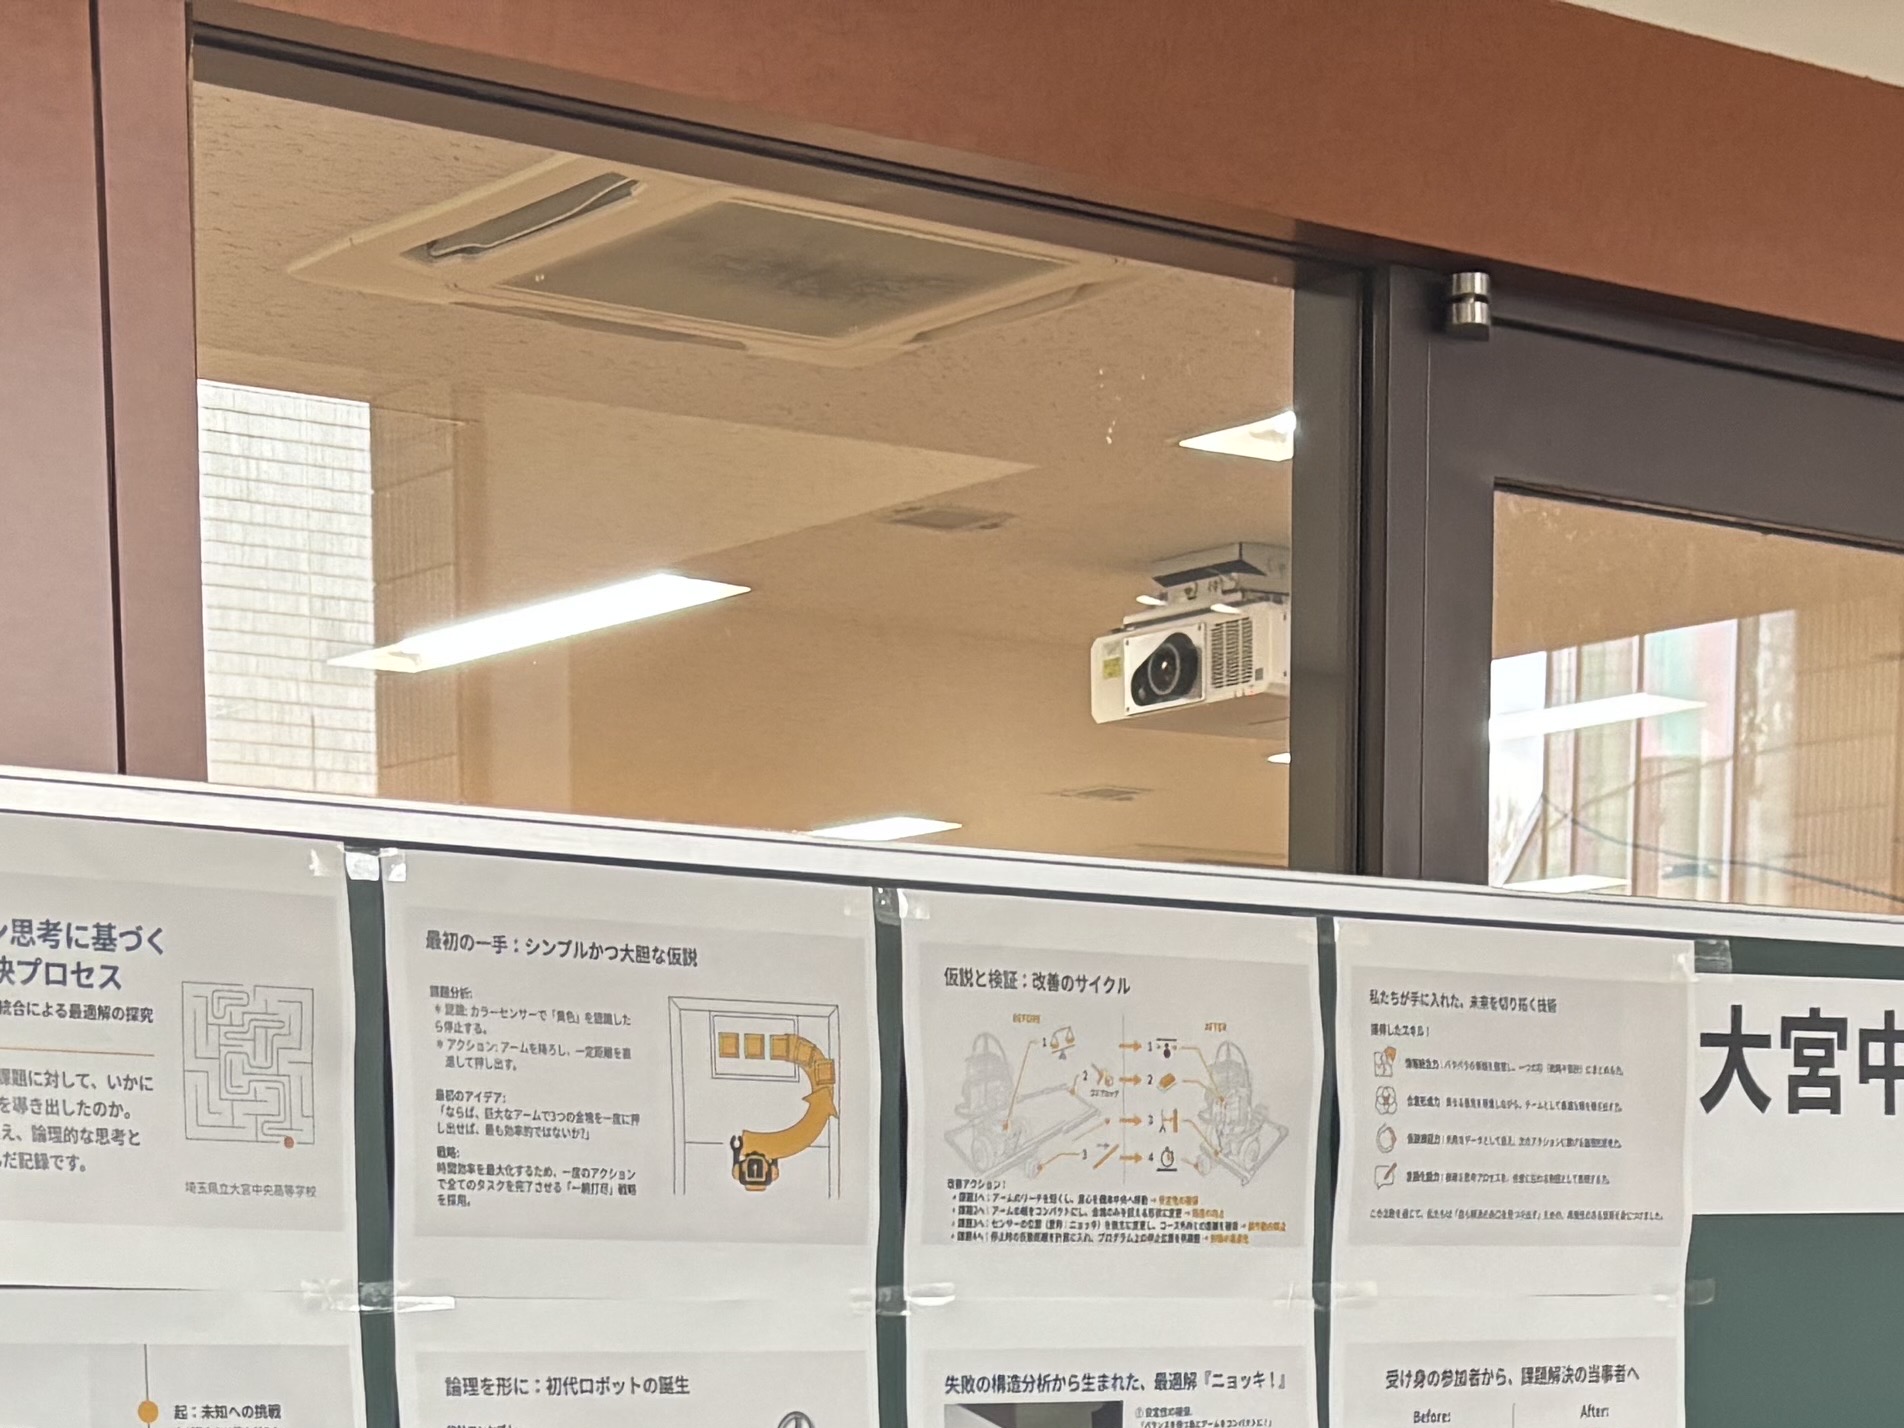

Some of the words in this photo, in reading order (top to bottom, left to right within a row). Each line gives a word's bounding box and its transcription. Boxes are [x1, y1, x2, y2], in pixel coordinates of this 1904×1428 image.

[426, 930, 697, 967] 最初の一手：シンプルかつ大胆な仮説
[944, 967, 1130, 994] 仮説と検証：改善のサイクル
[185, 1182, 316, 1197] 埼玉県立大宮中央高等学校
[445, 1375, 690, 1396] 論理を形に：初代ロボットの誕生
[945, 1371, 1284, 1394] 失敗の構造分析から生まれた、最適解『ニョッキ！』
[174, 1404, 281, 1419] 起：未知への挑戦
